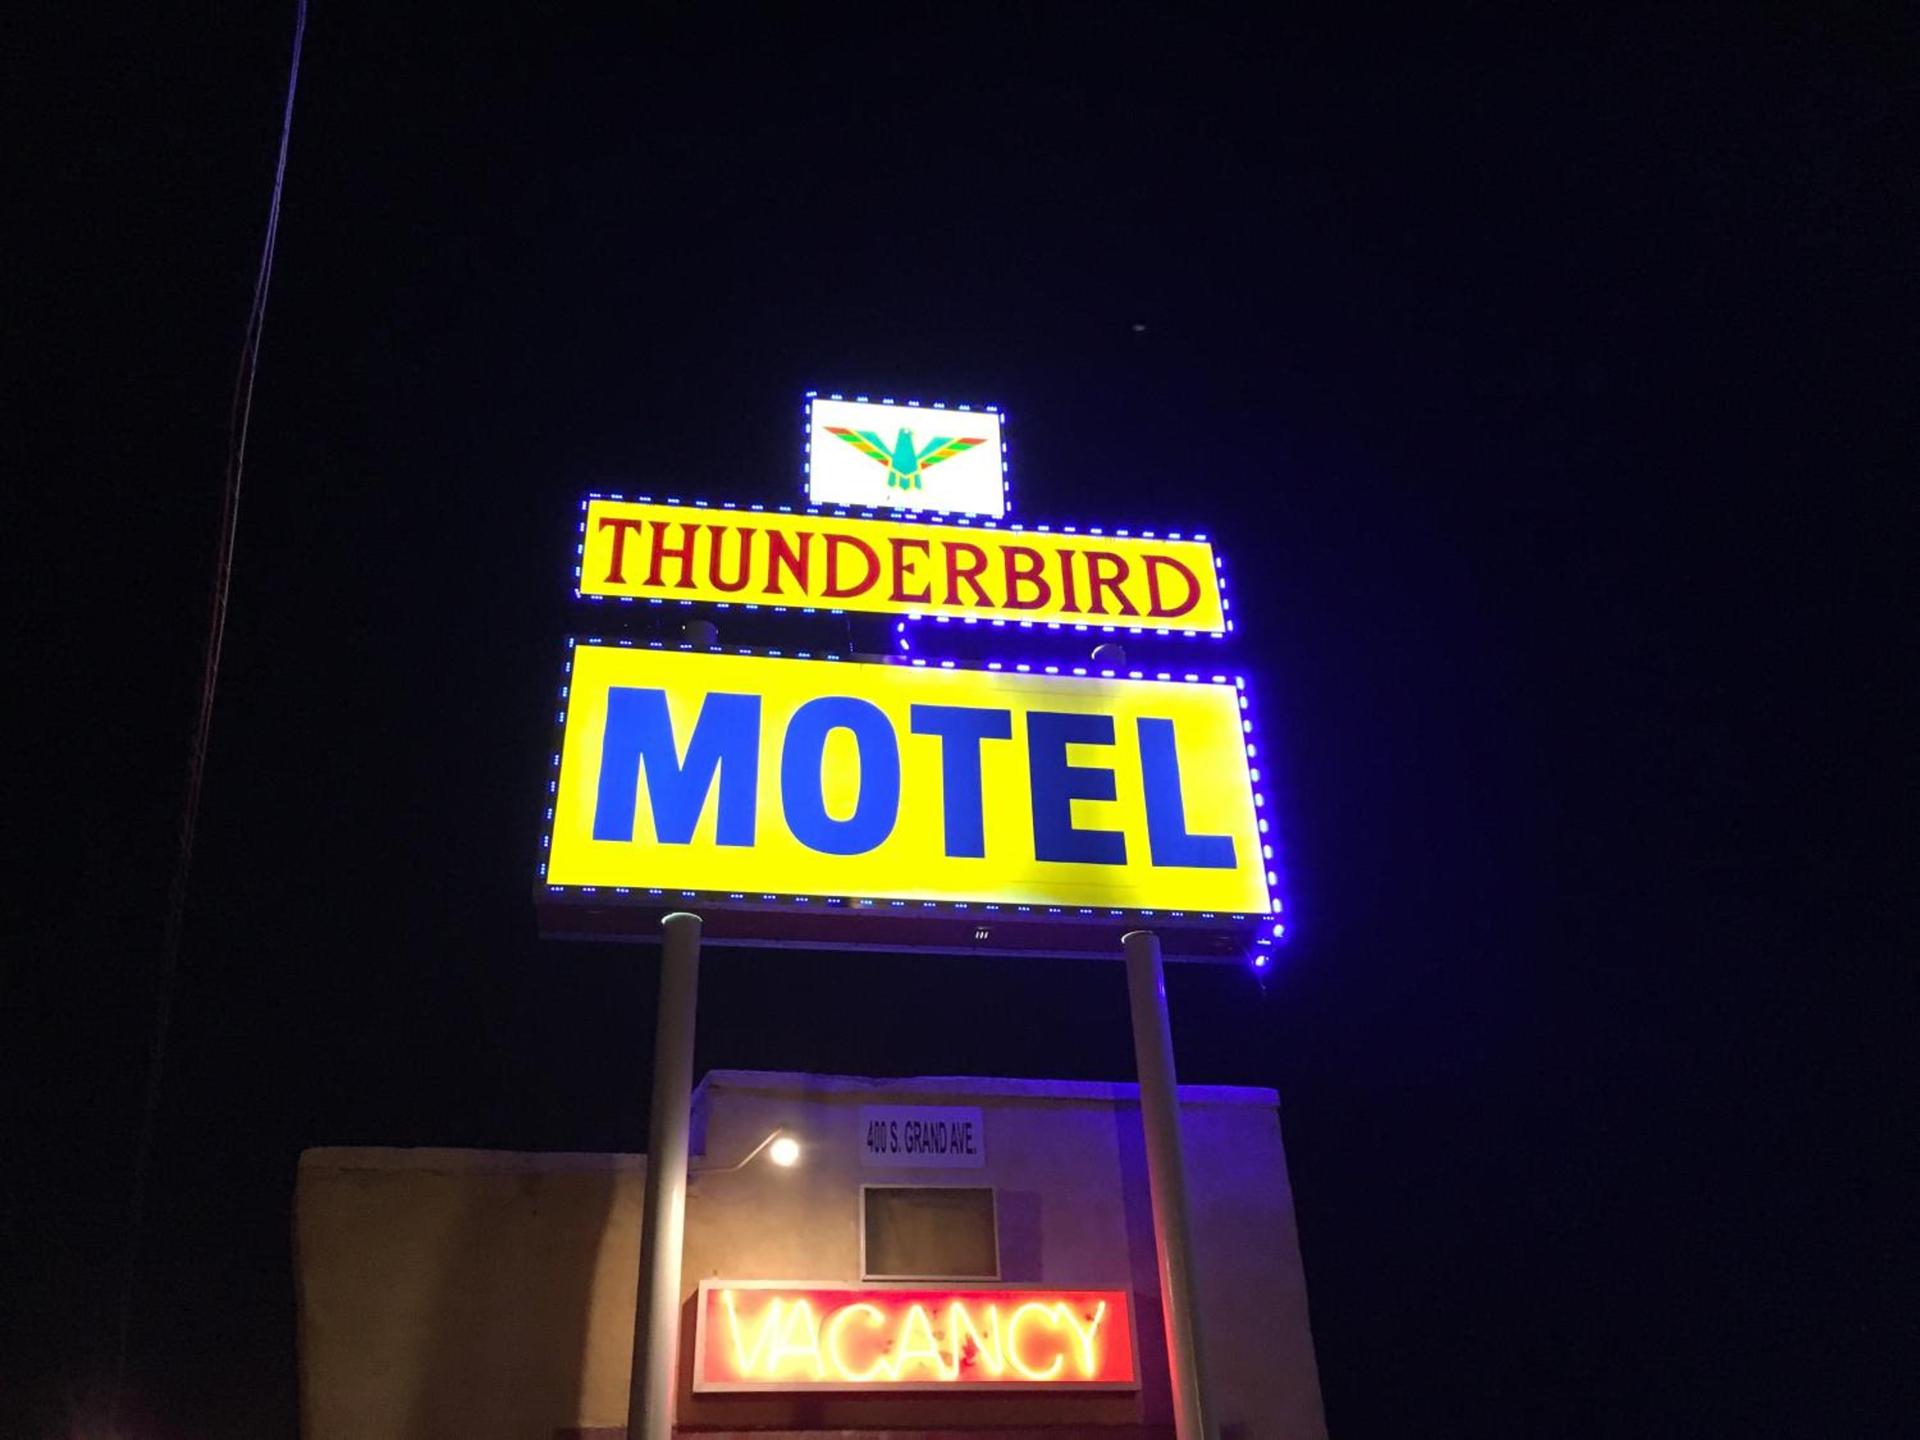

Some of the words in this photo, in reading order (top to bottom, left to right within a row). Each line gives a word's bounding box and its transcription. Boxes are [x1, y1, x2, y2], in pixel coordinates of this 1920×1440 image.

[598, 517, 1201, 619] THUNDERBIRD
[592, 686, 1238, 870] MOTEL
[867, 1120, 887, 1153] 400
[890, 1120, 902, 1153] S.
[904, 1120, 948, 1154] GRAND
[950, 1121, 978, 1155] AVE.
[719, 1288, 1106, 1382] VACANCY
